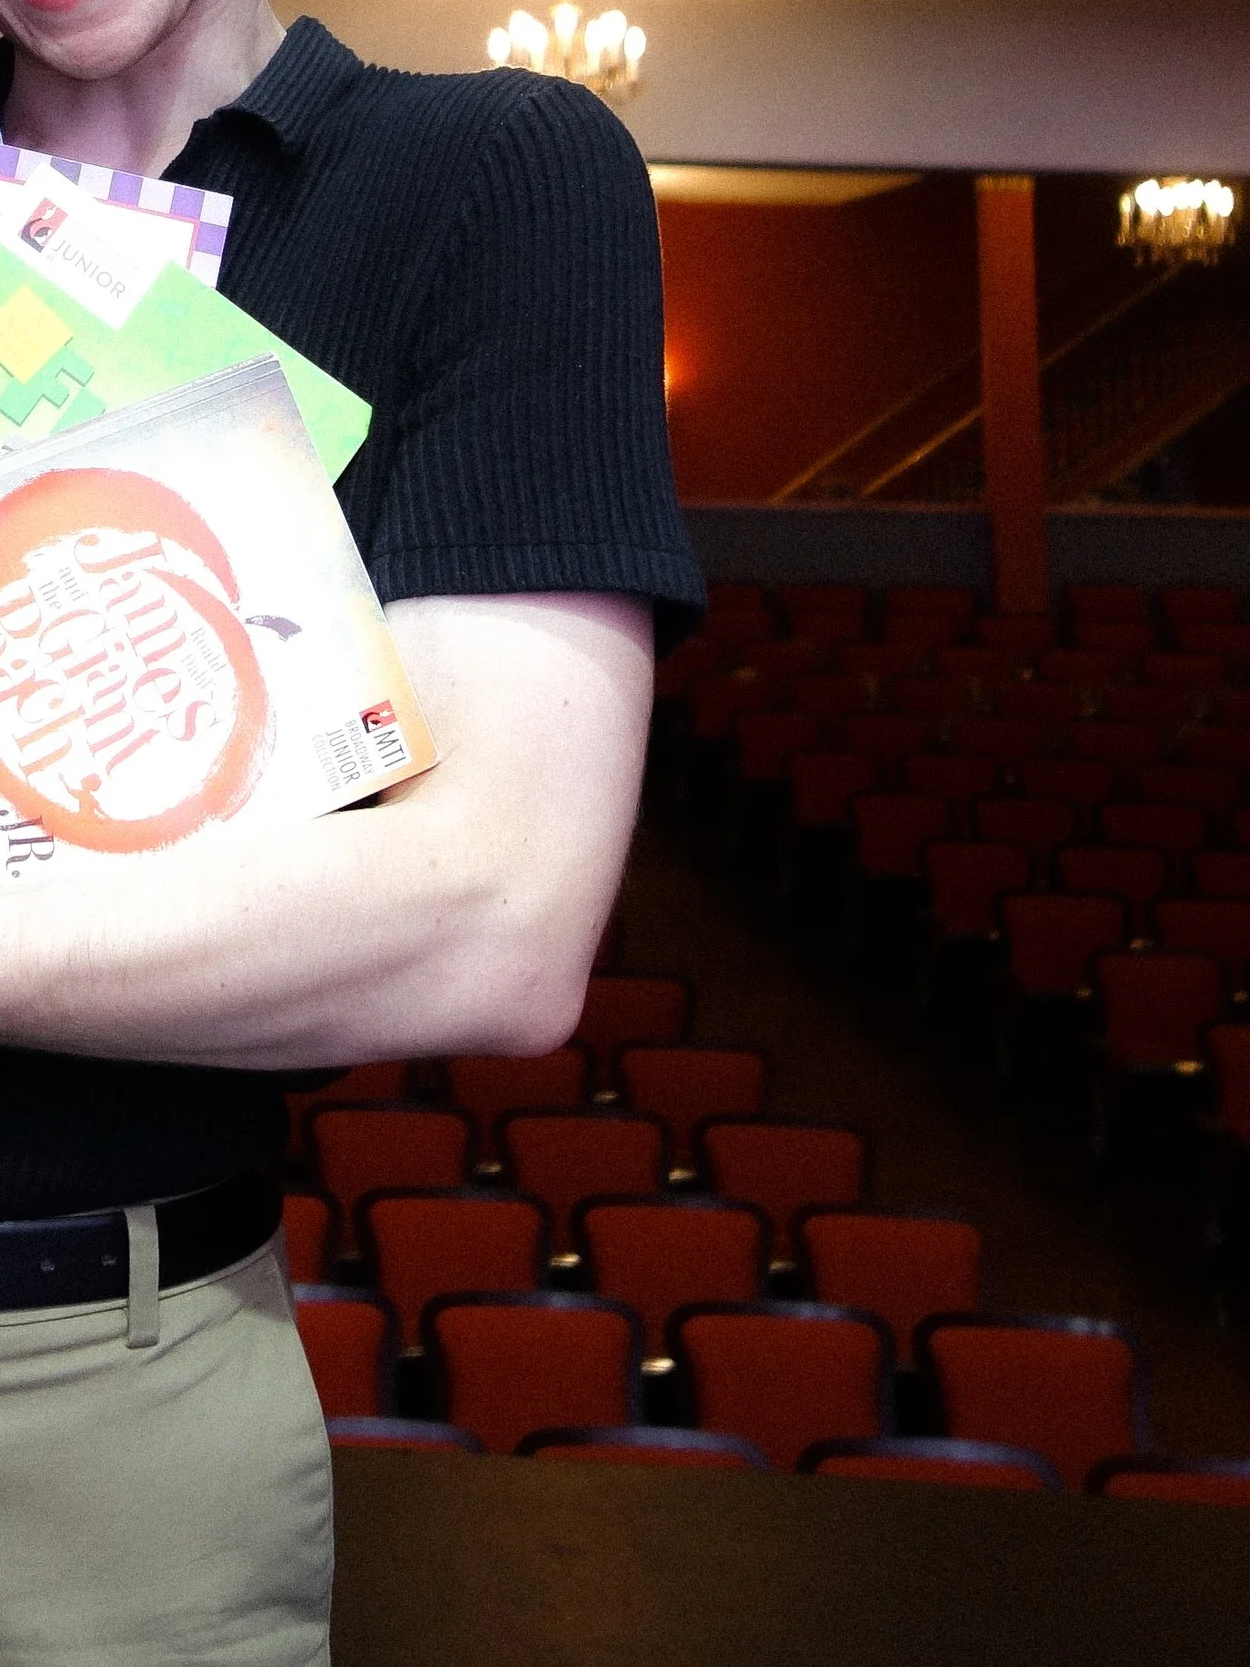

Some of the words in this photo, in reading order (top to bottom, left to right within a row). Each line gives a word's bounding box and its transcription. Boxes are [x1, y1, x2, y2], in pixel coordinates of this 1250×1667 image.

[51, 239, 127, 299] JUNIOR
[39, 581, 62, 610] the
[58, 566, 89, 602] and
[73, 532, 224, 741] James
[190, 626, 227, 673] Roald
[38, 608, 161, 777] Giant
[311, 734, 342, 792] COLLECTION
[325, 728, 361, 785] JUNIOR
[345, 719, 375, 775] BROADWAY
[373, 729, 406, 768] MTI
